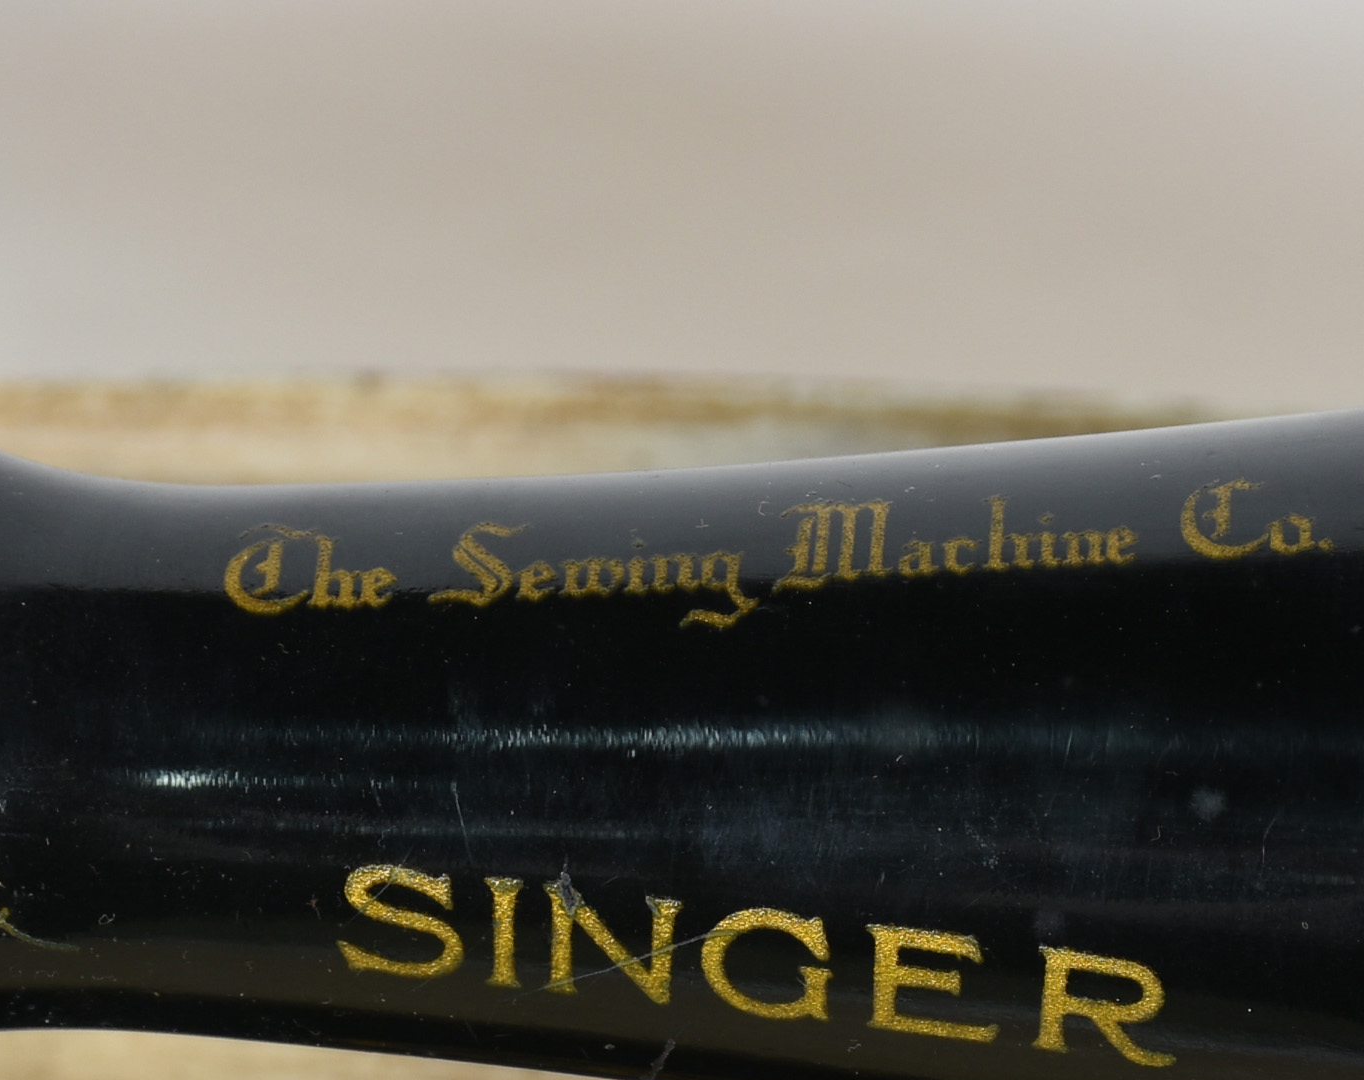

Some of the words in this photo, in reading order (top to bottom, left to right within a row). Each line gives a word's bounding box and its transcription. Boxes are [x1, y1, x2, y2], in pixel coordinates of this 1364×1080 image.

[224, 522, 398, 616] The
[428, 521, 758, 630] Sewing
[772, 495, 1139, 595] Machine
[1180, 480, 1335, 559] Co.
[336, 863, 1178, 1068] SINGER
